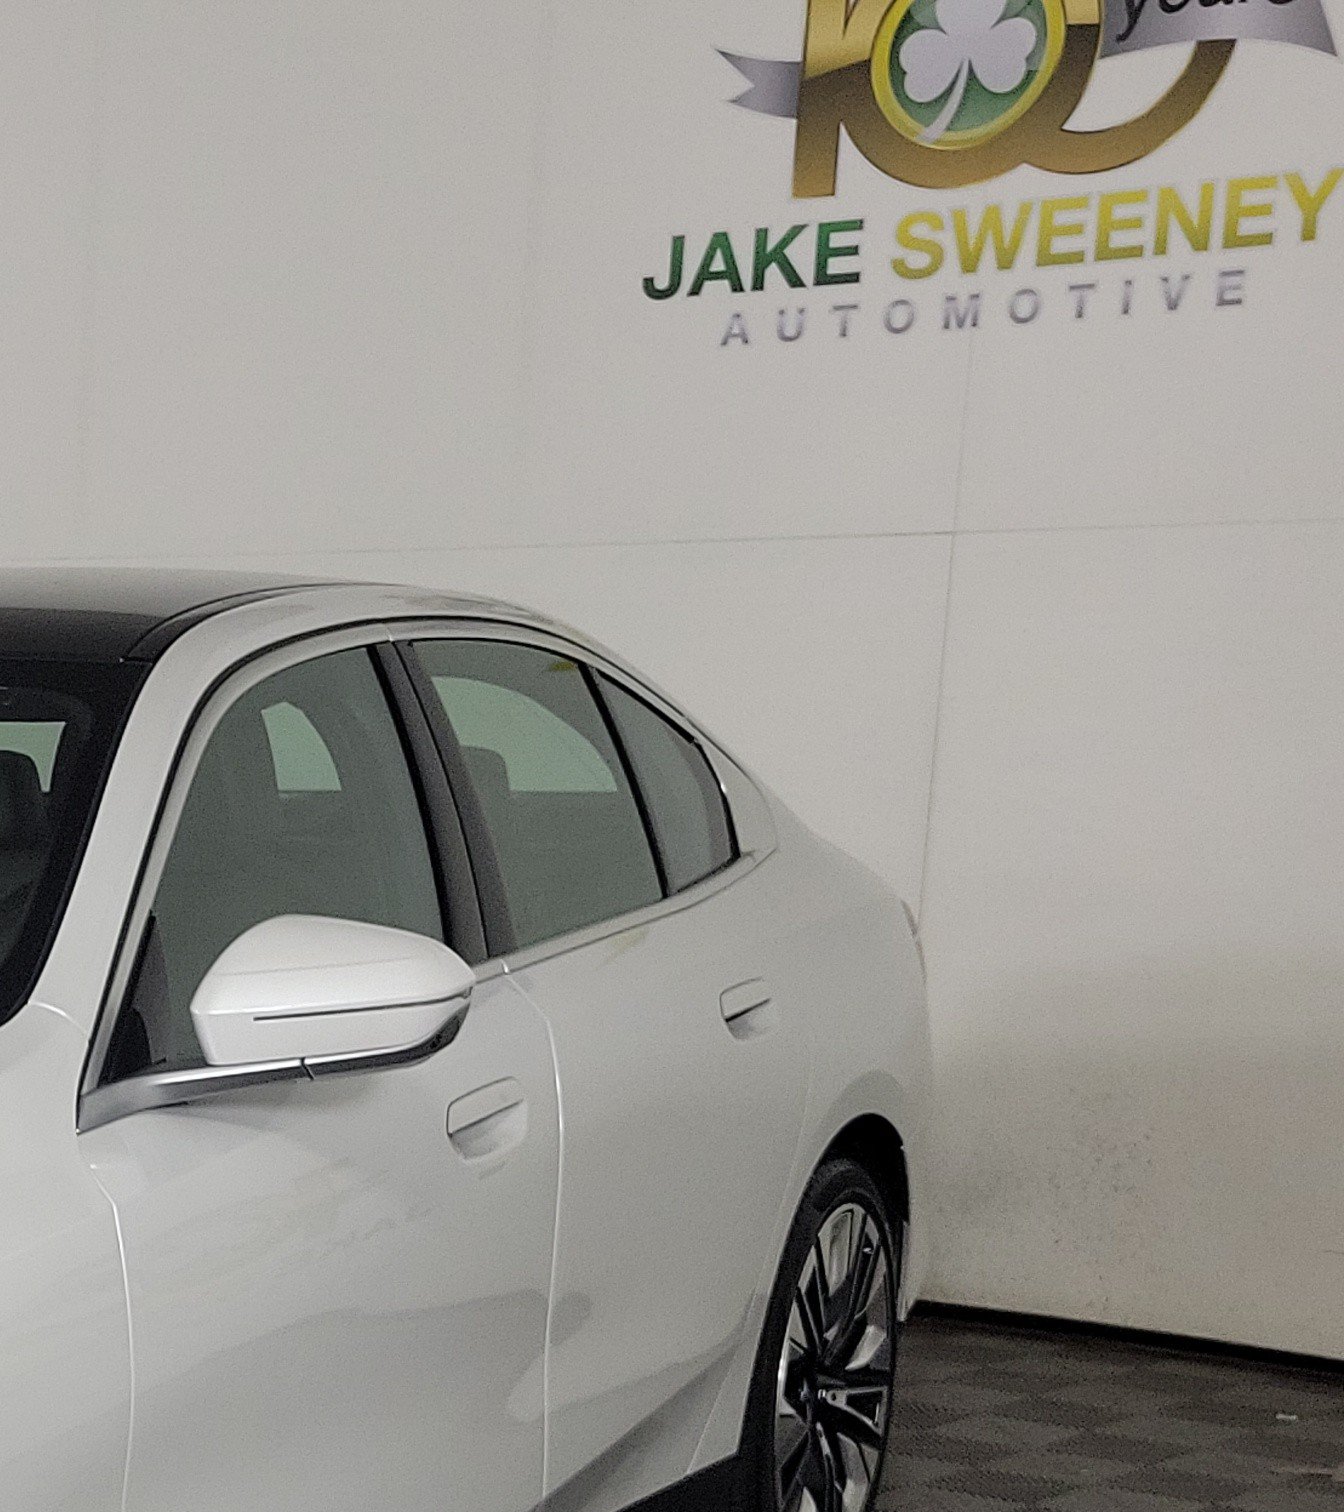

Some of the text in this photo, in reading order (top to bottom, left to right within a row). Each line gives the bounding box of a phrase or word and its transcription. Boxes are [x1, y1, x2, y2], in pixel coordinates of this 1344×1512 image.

[642, 167, 1343, 300] JAKE SWEENEY
[720, 269, 1246, 347] AUTOMOTIVE
